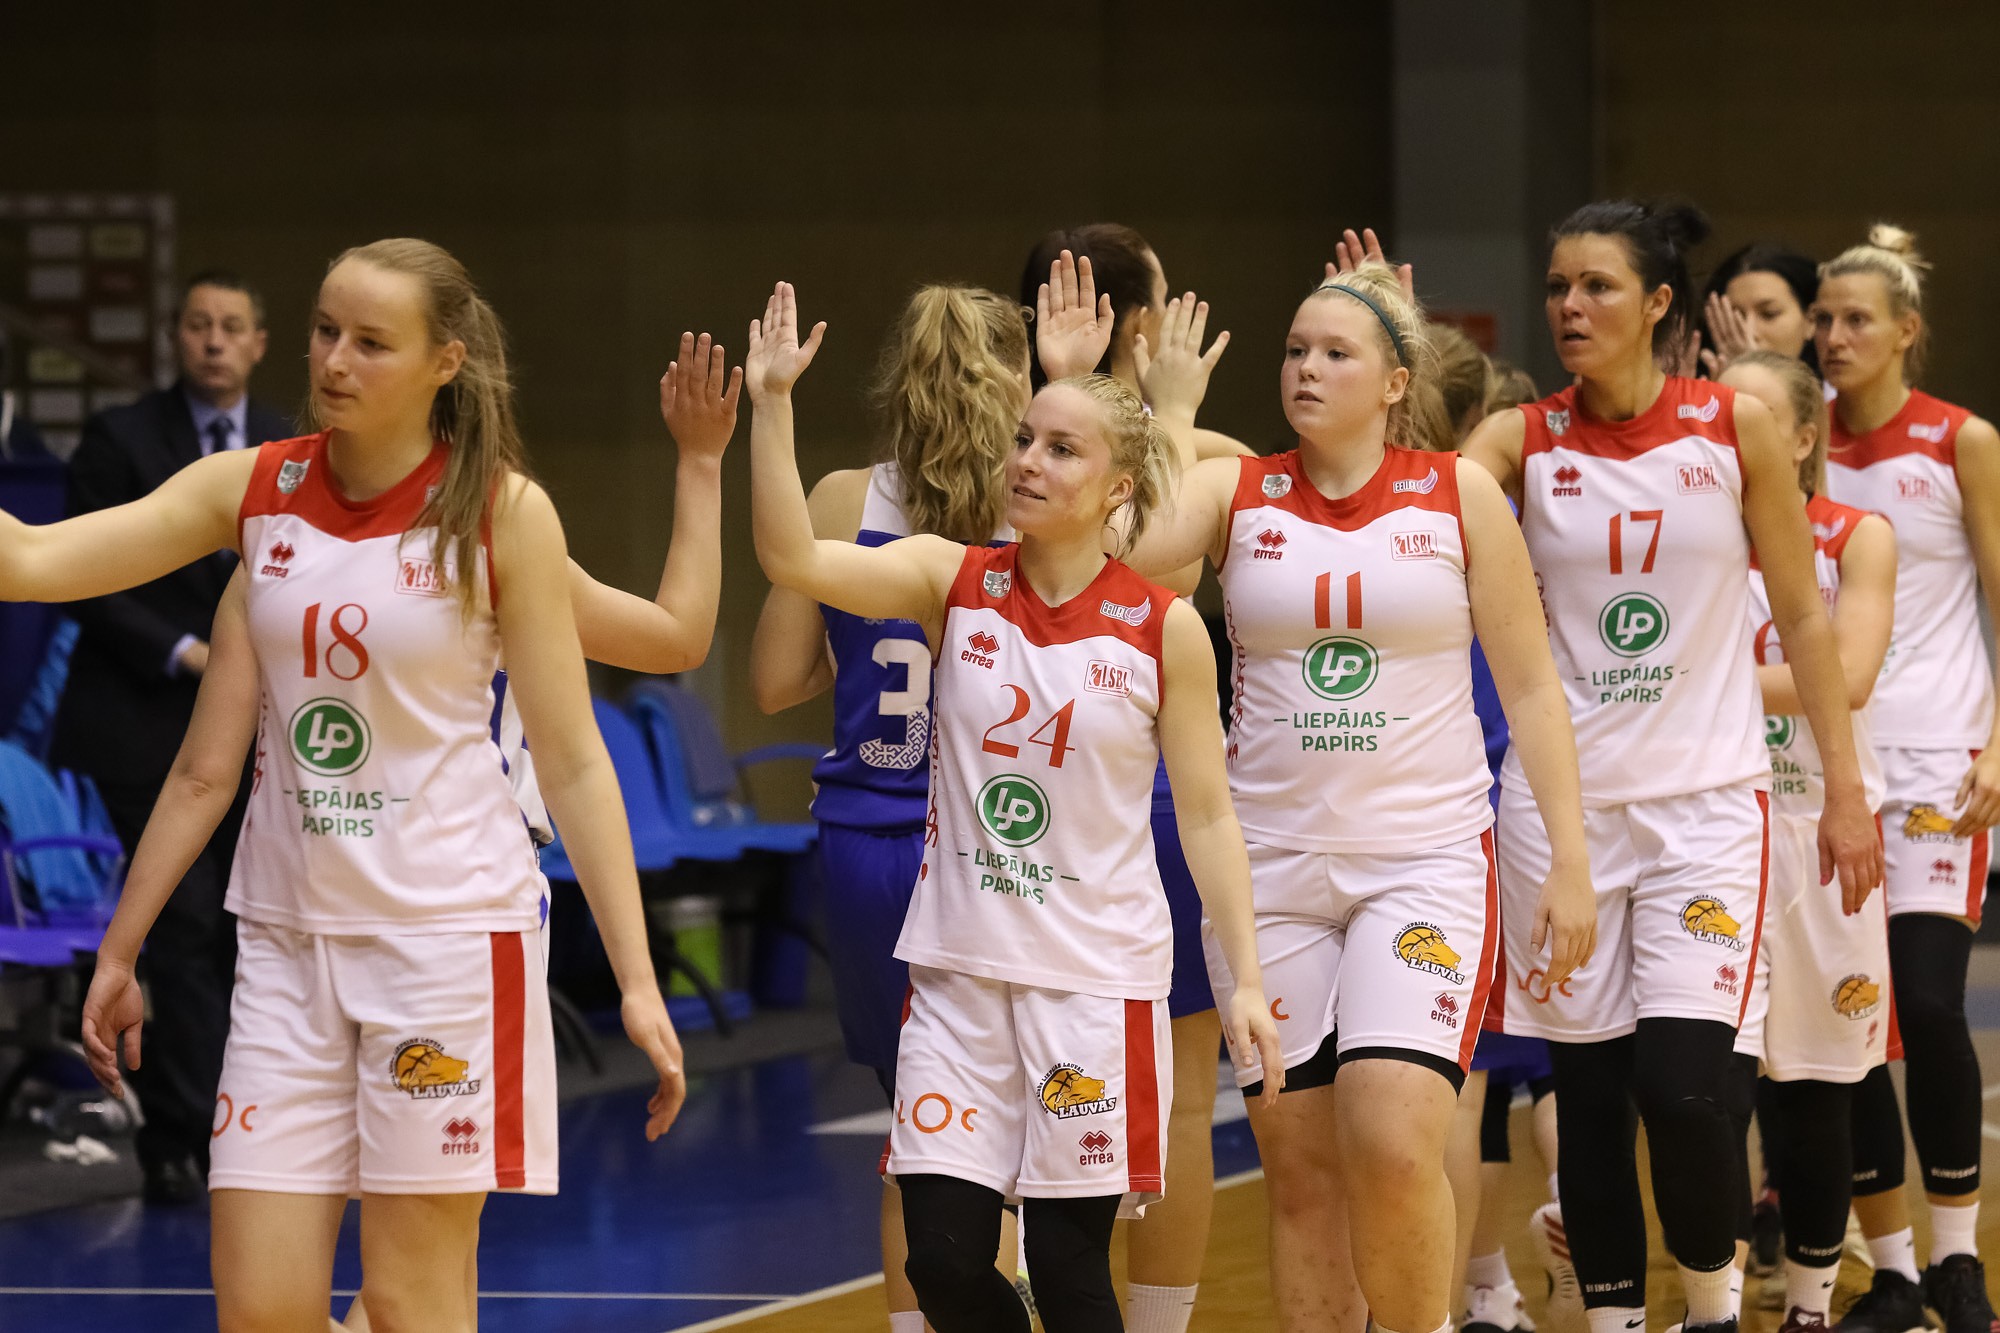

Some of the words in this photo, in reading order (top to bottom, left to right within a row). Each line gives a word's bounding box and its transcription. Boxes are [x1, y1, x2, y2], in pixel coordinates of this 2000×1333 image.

[1609, 509, 1663, 575] 17
[1314, 571, 1363, 629] 11
[303, 602, 369, 681] 18
[960, 649, 995, 670] errea
[1592, 663, 1675, 686] LIEPĀJAS
[858, 638, 933, 770] 3
[981, 683, 1076, 769] 24
[1293, 708, 1387, 728] LIEPĀJAS
[1302, 731, 1378, 752] PAPĪRS
[297, 785, 383, 810] EPĀJAS
[974, 848, 1054, 882] LIEPĀJAS
[980, 873, 1045, 905] PAPĪRS
[1694, 929, 1746, 953] LAUVAS
[1407, 956, 1466, 986] LAUVAS
[1430, 1009, 1457, 1029] errea
[411, 1080, 480, 1100] LAUVAS
[1058, 1097, 1117, 1119] LAUVAS
[442, 1141, 480, 1155] errea
[1079, 1151, 1115, 1166] errea
